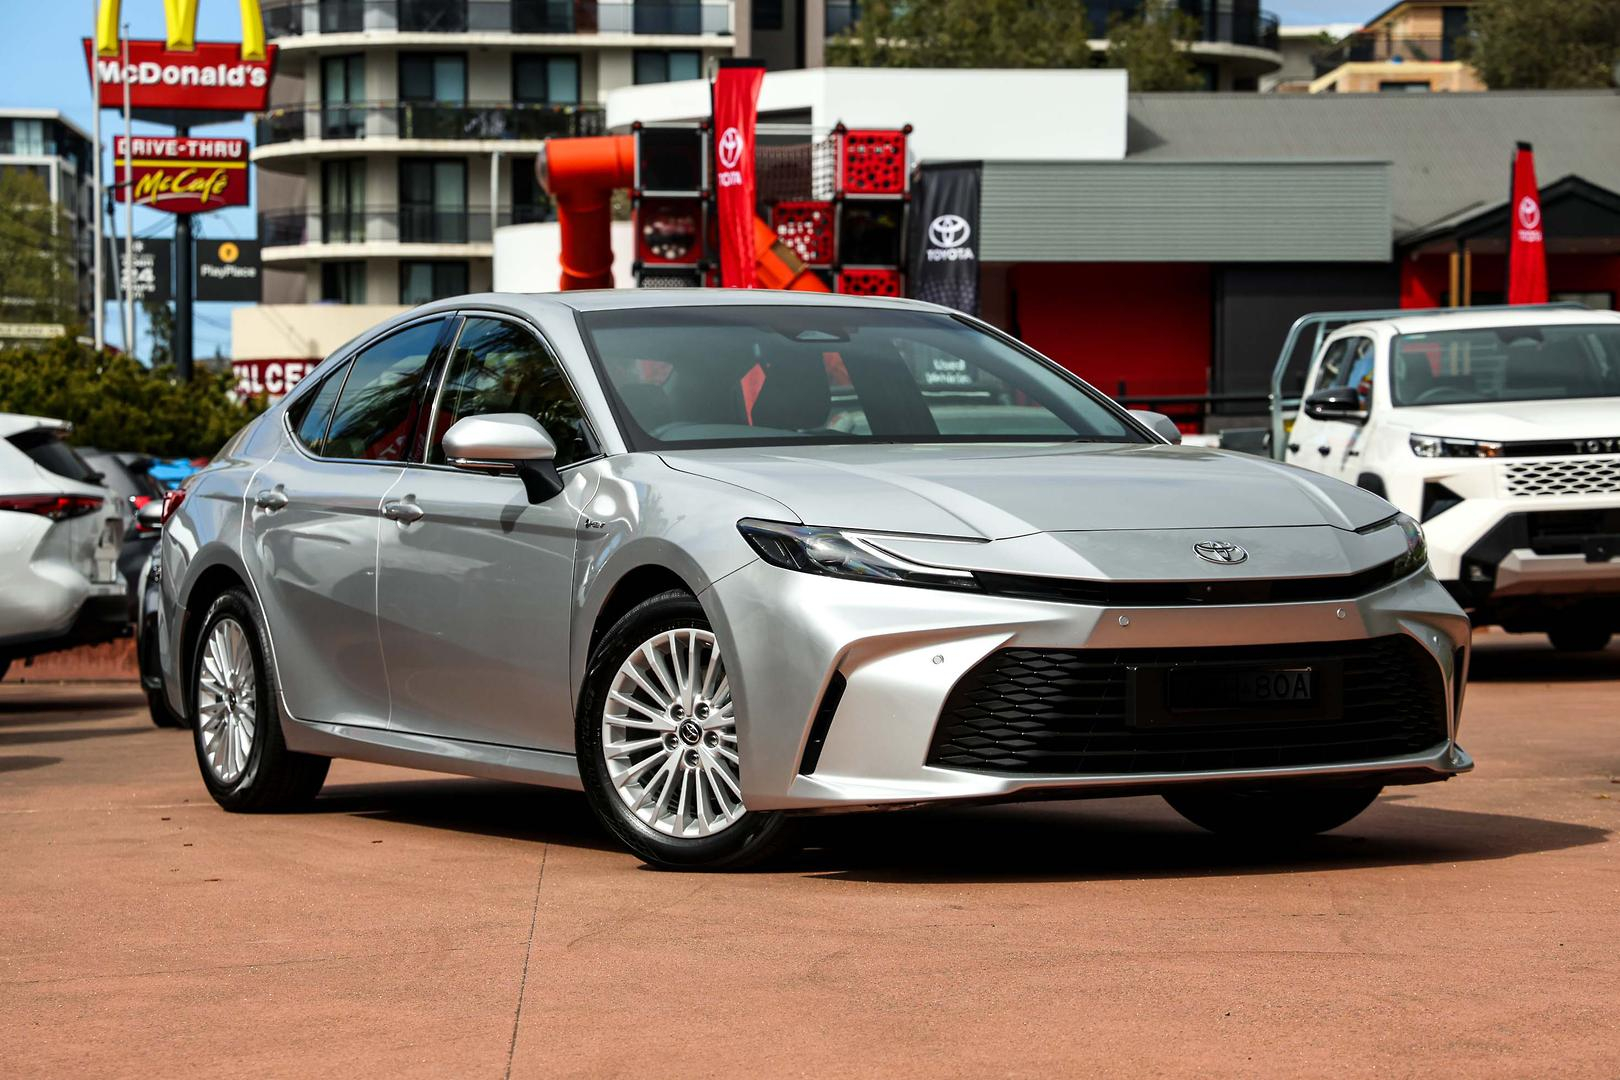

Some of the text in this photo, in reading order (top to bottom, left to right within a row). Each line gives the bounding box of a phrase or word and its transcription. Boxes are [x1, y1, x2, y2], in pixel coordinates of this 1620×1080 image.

[98, 61, 267, 88] McDonald's
[134, 167, 228, 204] McCafé
[926, 247, 975, 261] TOYOTA
[200, 263, 257, 279] PlayPlace
